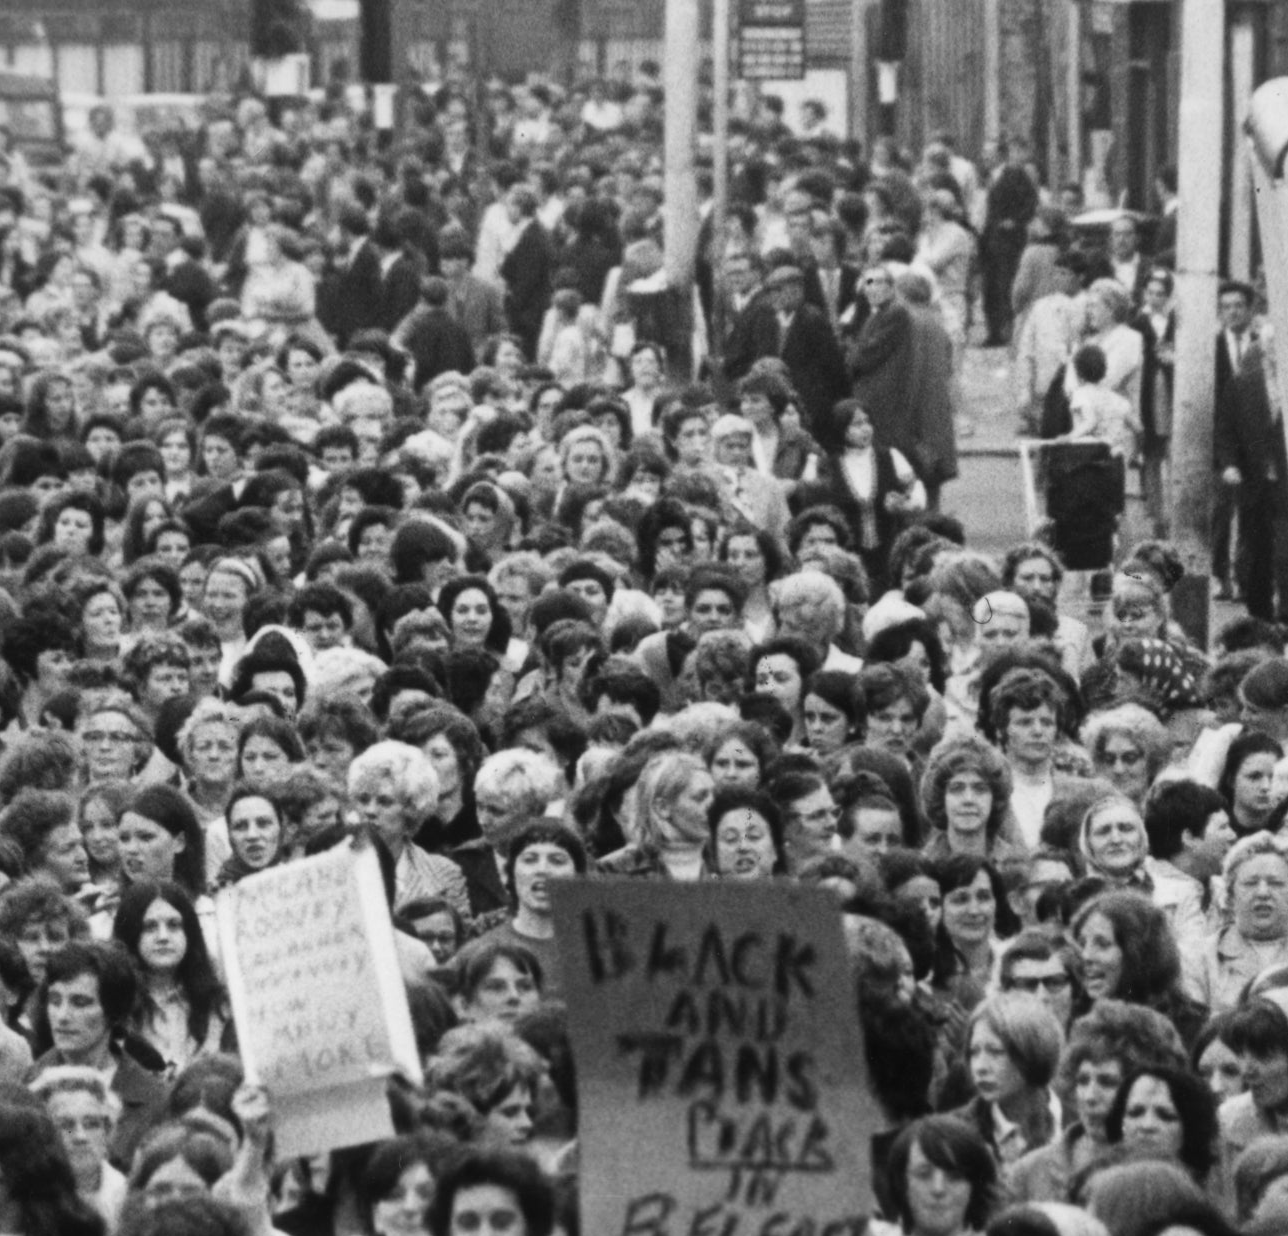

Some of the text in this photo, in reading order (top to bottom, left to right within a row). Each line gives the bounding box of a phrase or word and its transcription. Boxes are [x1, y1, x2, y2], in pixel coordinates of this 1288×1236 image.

[582, 910, 816, 1000] BLACK
[665, 990, 787, 1042] AND
[616, 1033, 815, 1110] TANS
